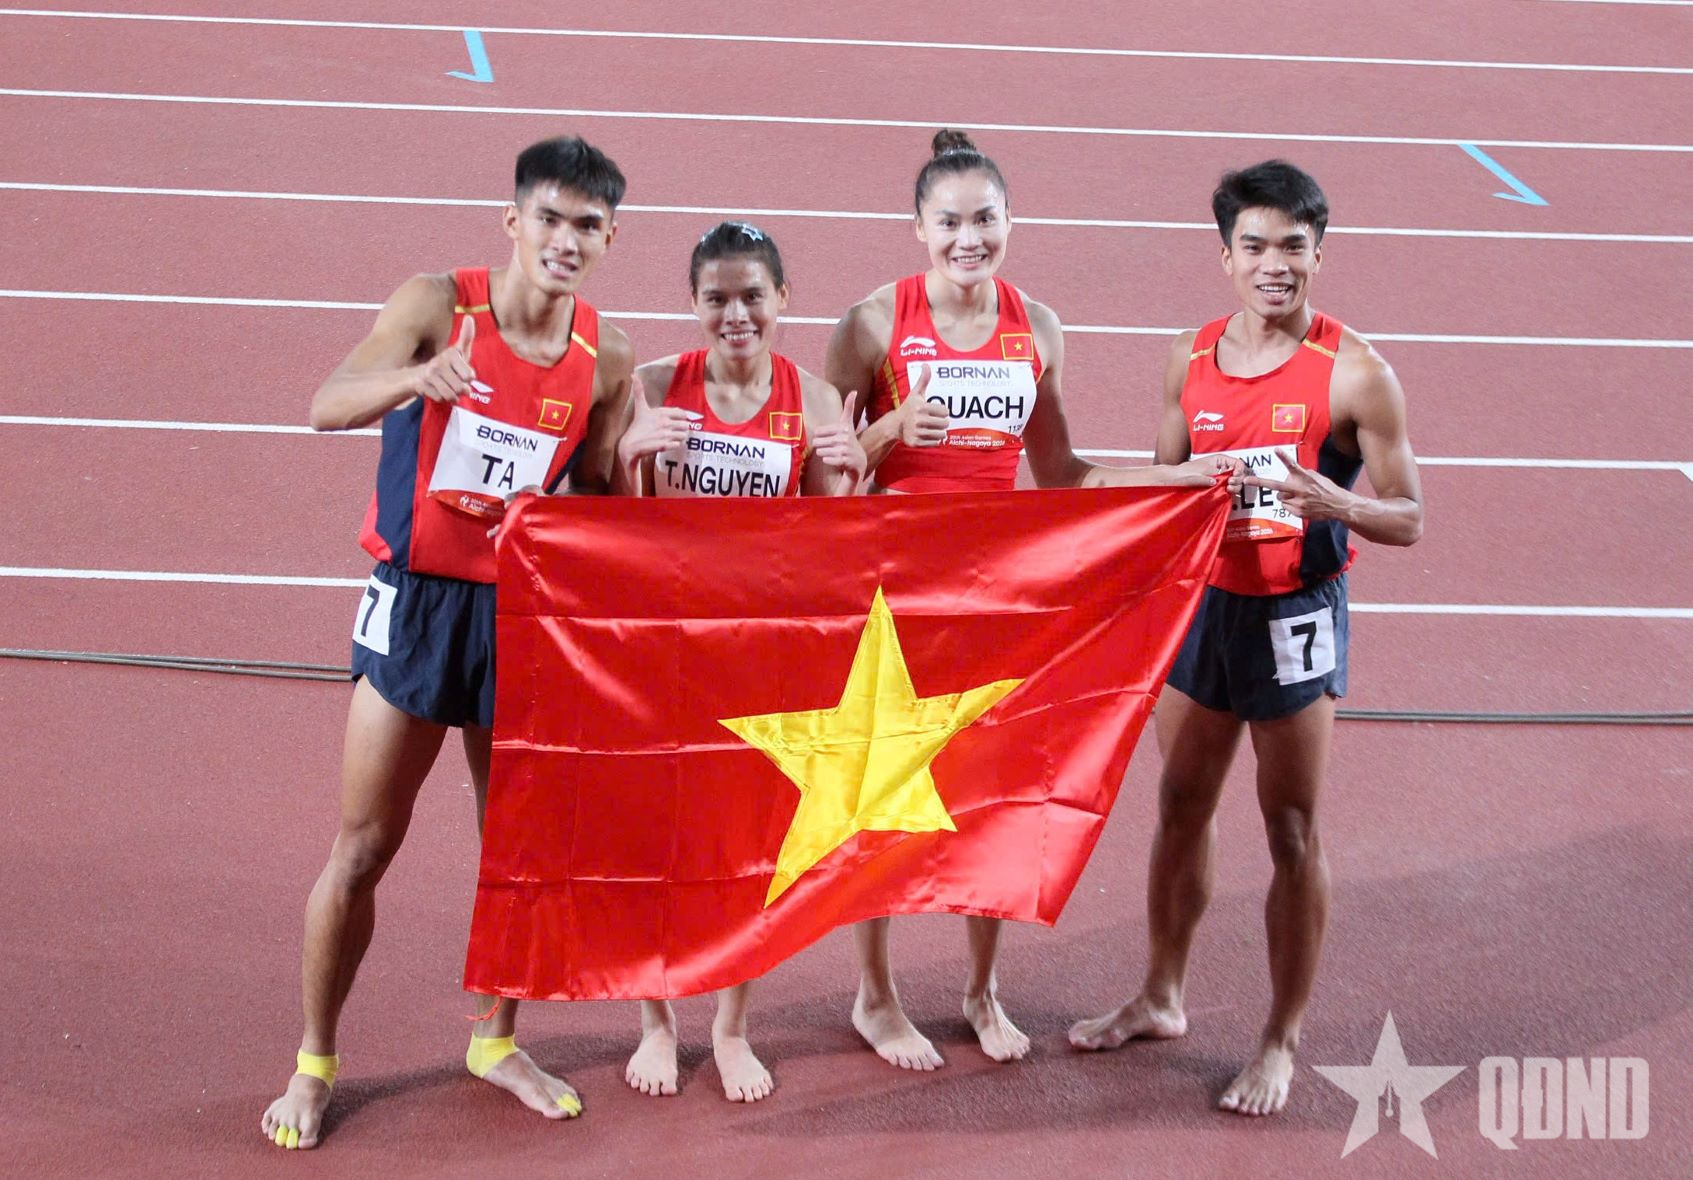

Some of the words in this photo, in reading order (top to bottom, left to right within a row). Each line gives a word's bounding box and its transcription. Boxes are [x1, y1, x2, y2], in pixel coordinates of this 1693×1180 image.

[936, 366, 1010, 379] BORNAN
[476, 424, 539, 452] BORNAN
[1193, 423, 1225, 432] LI-NING
[686, 437, 765, 459] BORNAN
[481, 453, 515, 490] TA
[665, 460, 780, 497] T.NGUYEN
[361, 584, 380, 637] 7
[1290, 620, 1317, 672] 7
